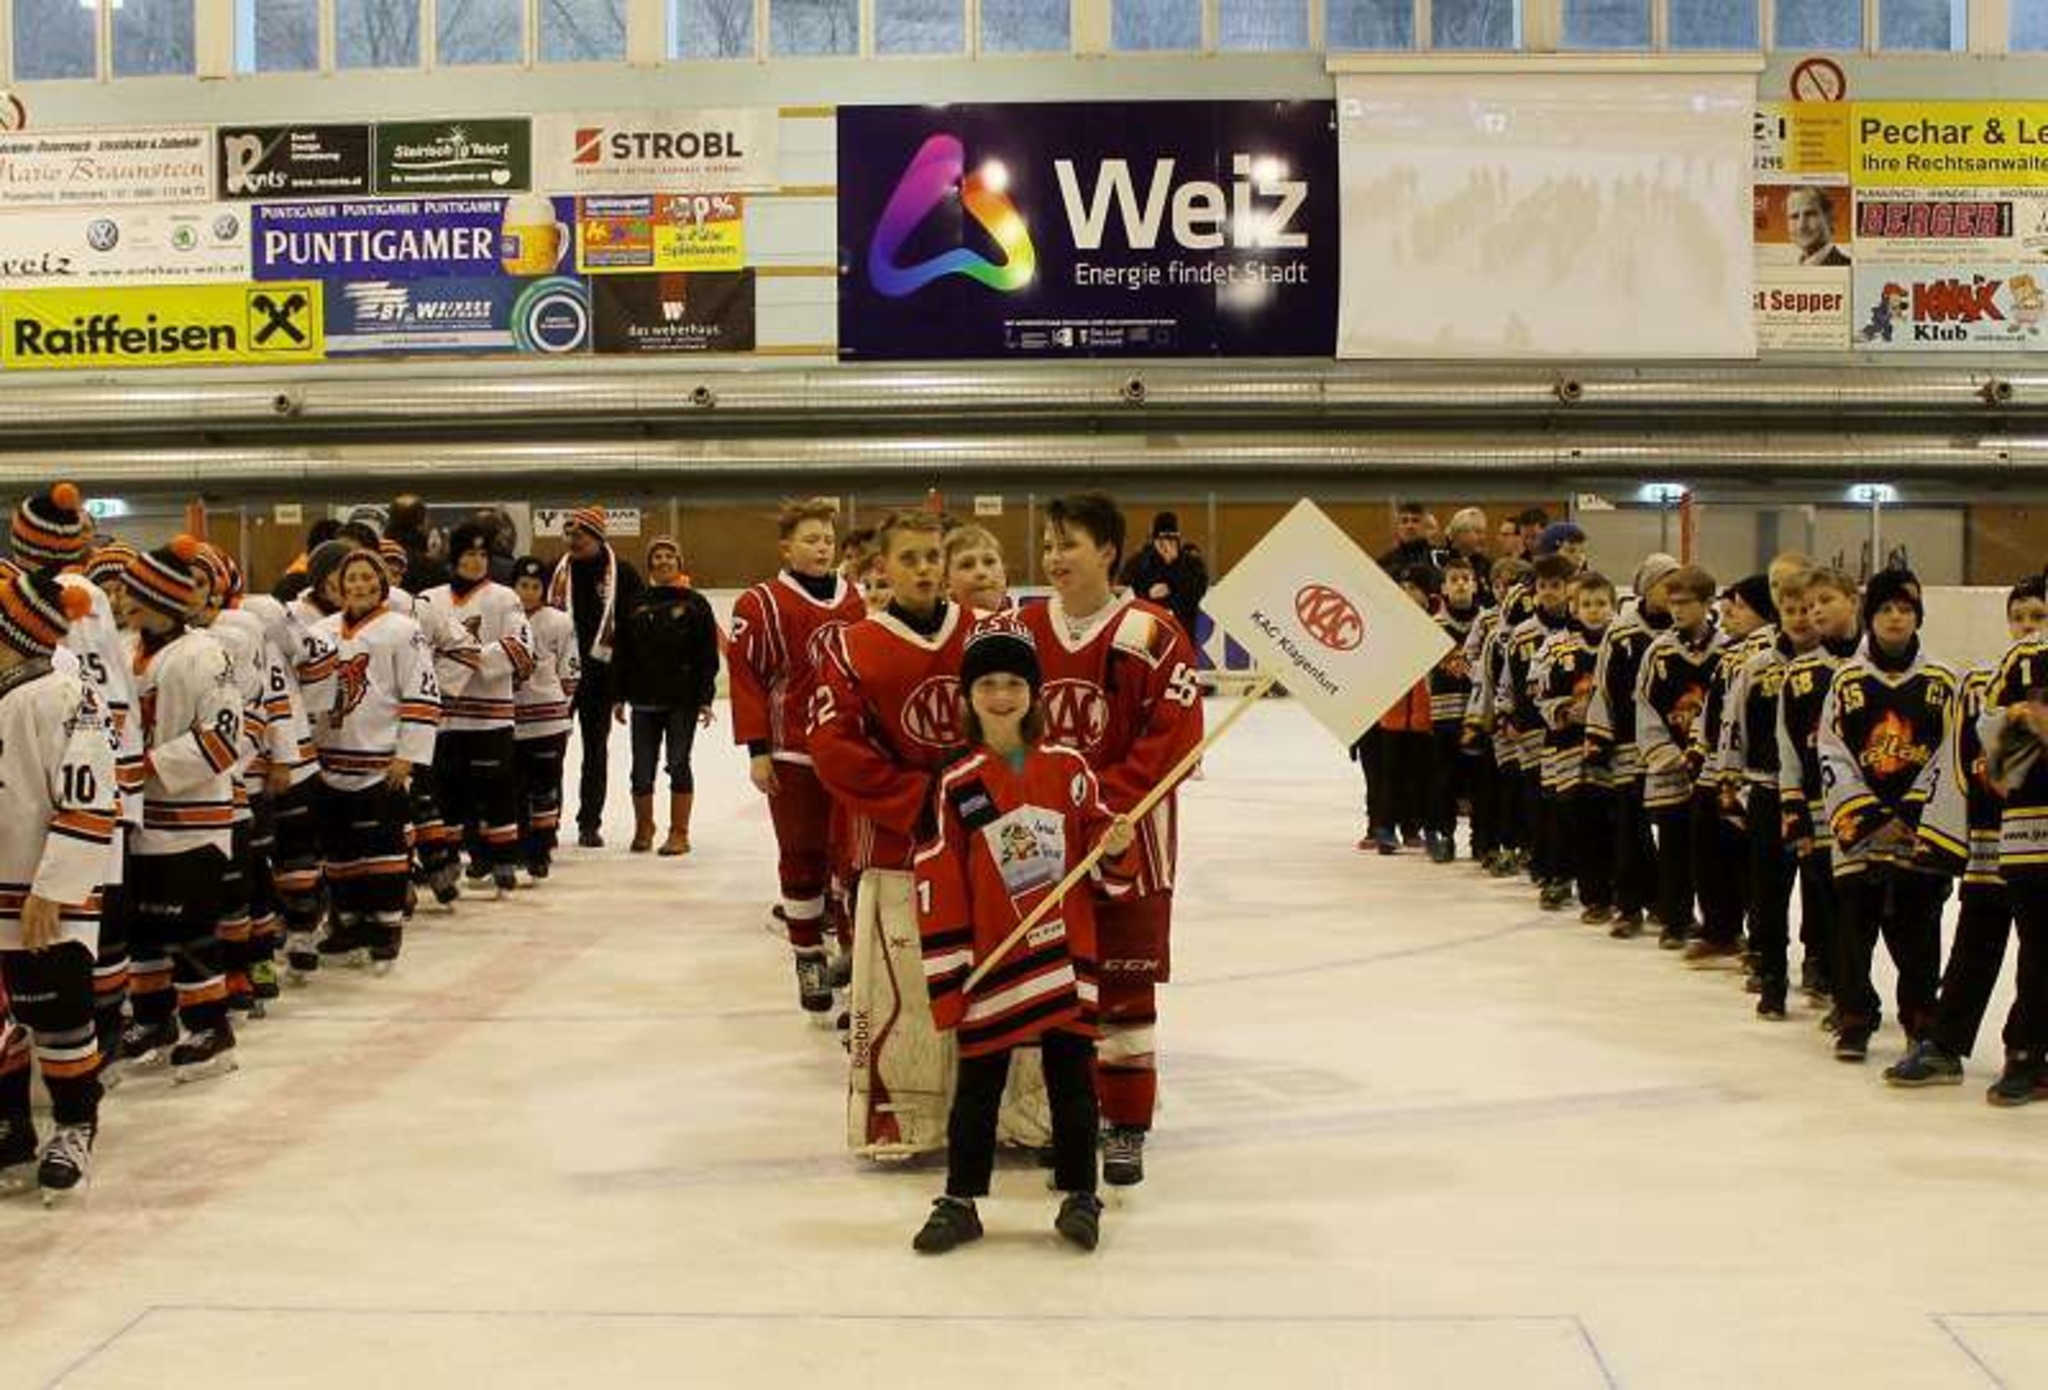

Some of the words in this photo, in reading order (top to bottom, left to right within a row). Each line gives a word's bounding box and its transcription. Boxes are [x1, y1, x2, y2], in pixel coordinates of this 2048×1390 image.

[611, 131, 743, 160] STROBL
[1860, 118, 1973, 145] Pechar
[1983, 118, 2006, 144] &
[1862, 155, 1900, 171] Ihre
[261, 206, 337, 219] PUNTIGAMER
[342, 204, 419, 216] PUNTIGAMER
[424, 201, 500, 213] PUNTIGAMER
[1054, 152, 1308, 249] Weiz
[1861, 203, 1999, 236] BERGER
[264, 228, 493, 264] PUNTIGAMER
[1075, 263, 1161, 289] Energie
[1169, 260, 1235, 283] findet
[1244, 261, 1308, 283] Stadt
[1770, 291, 1843, 313] Sepper
[14, 314, 237, 356] Raiffeisen
[1914, 325, 1968, 341] Klub
[1251, 609, 1281, 639] KAC
[62, 763, 96, 804] 10
[853, 1010, 869, 1068] Reebok
